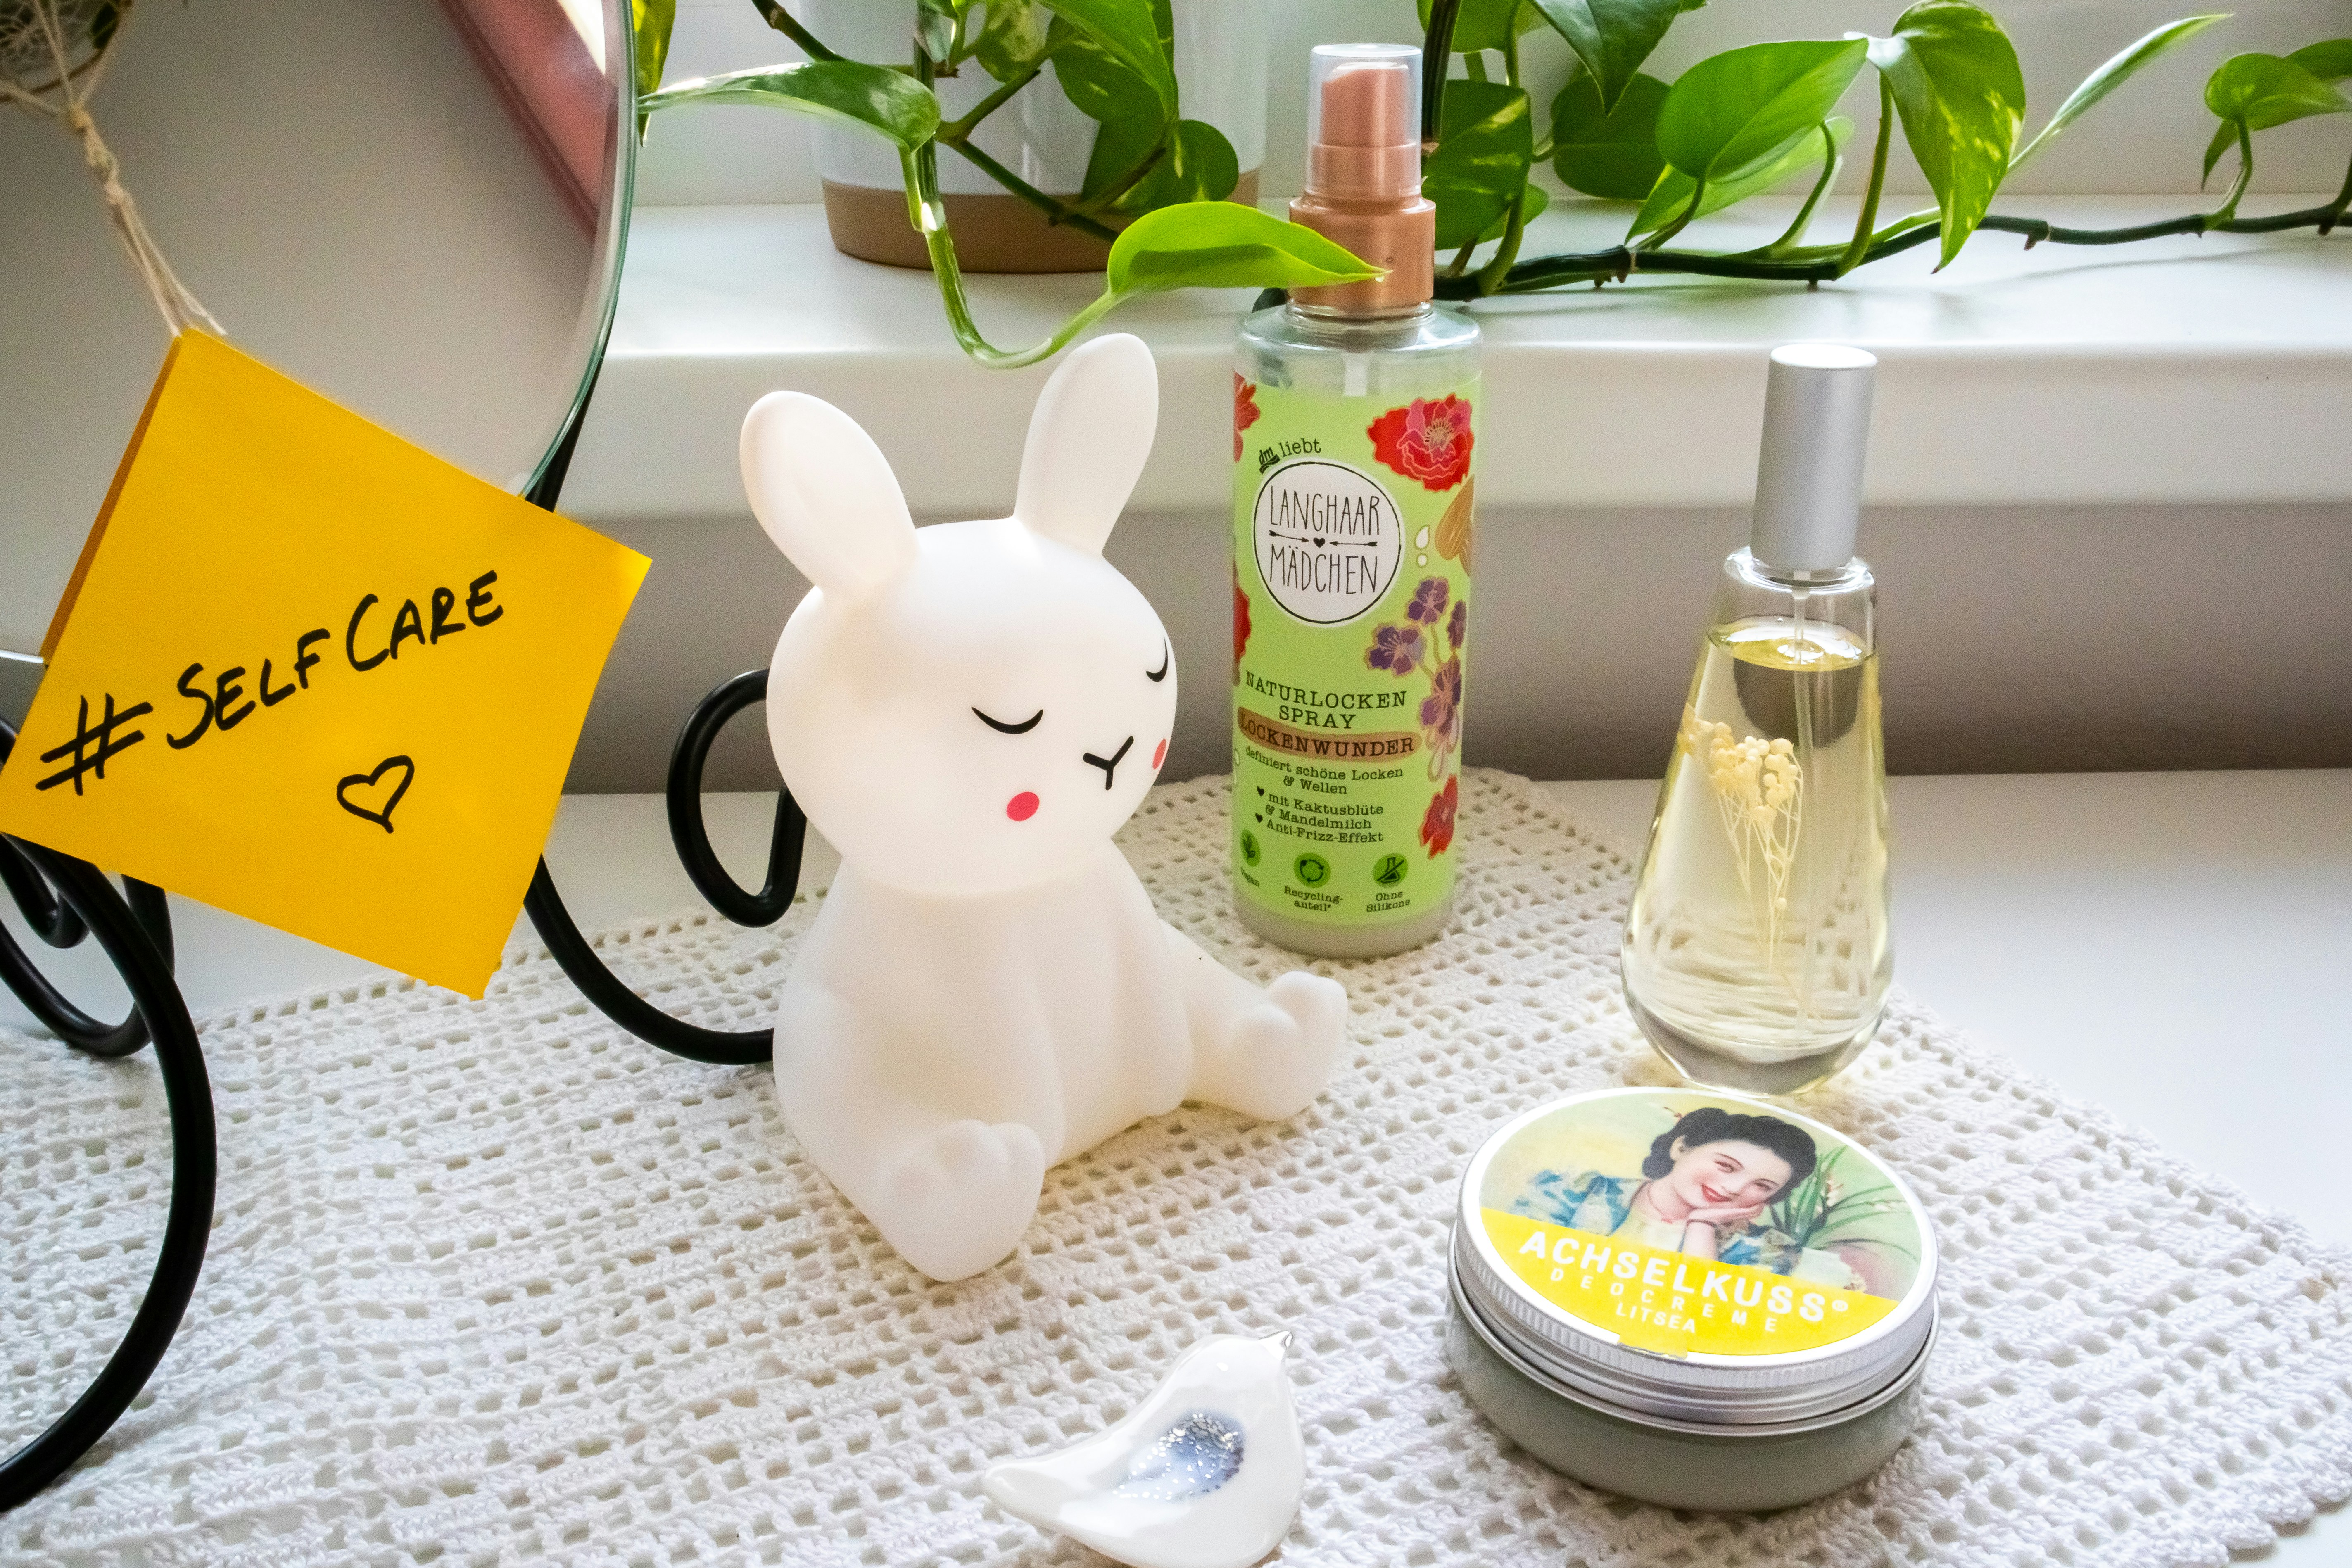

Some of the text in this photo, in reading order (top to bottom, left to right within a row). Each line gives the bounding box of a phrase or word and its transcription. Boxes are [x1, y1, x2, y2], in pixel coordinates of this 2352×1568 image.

[1278, 438, 1321, 457] liebt
[1270, 485, 1380, 535] LANGHAAR
[1270, 543, 1378, 595] MÄDCHEN
[1246, 670, 1407, 709] NATURLOCKEN
[1279, 705, 1356, 729] SPRAY
[1240, 713, 1414, 757] LOCKENWUNDER
[1246, 746, 1403, 781] definiert schöne Locken
[1283, 776, 1348, 794] & Wellen
[1269, 793, 1383, 815] mit Kaktusblüte
[1265, 804, 1372, 829] & Mandelmilch
[1267, 819, 1383, 843] Anti-Frizz-Effekt
[1284, 886, 1343, 904] Recycling-
[1366, 898, 1411, 912] Silikone
[1376, 891, 1403, 902] Ohne
[1616, 1302, 1695, 1333] LITSEA
